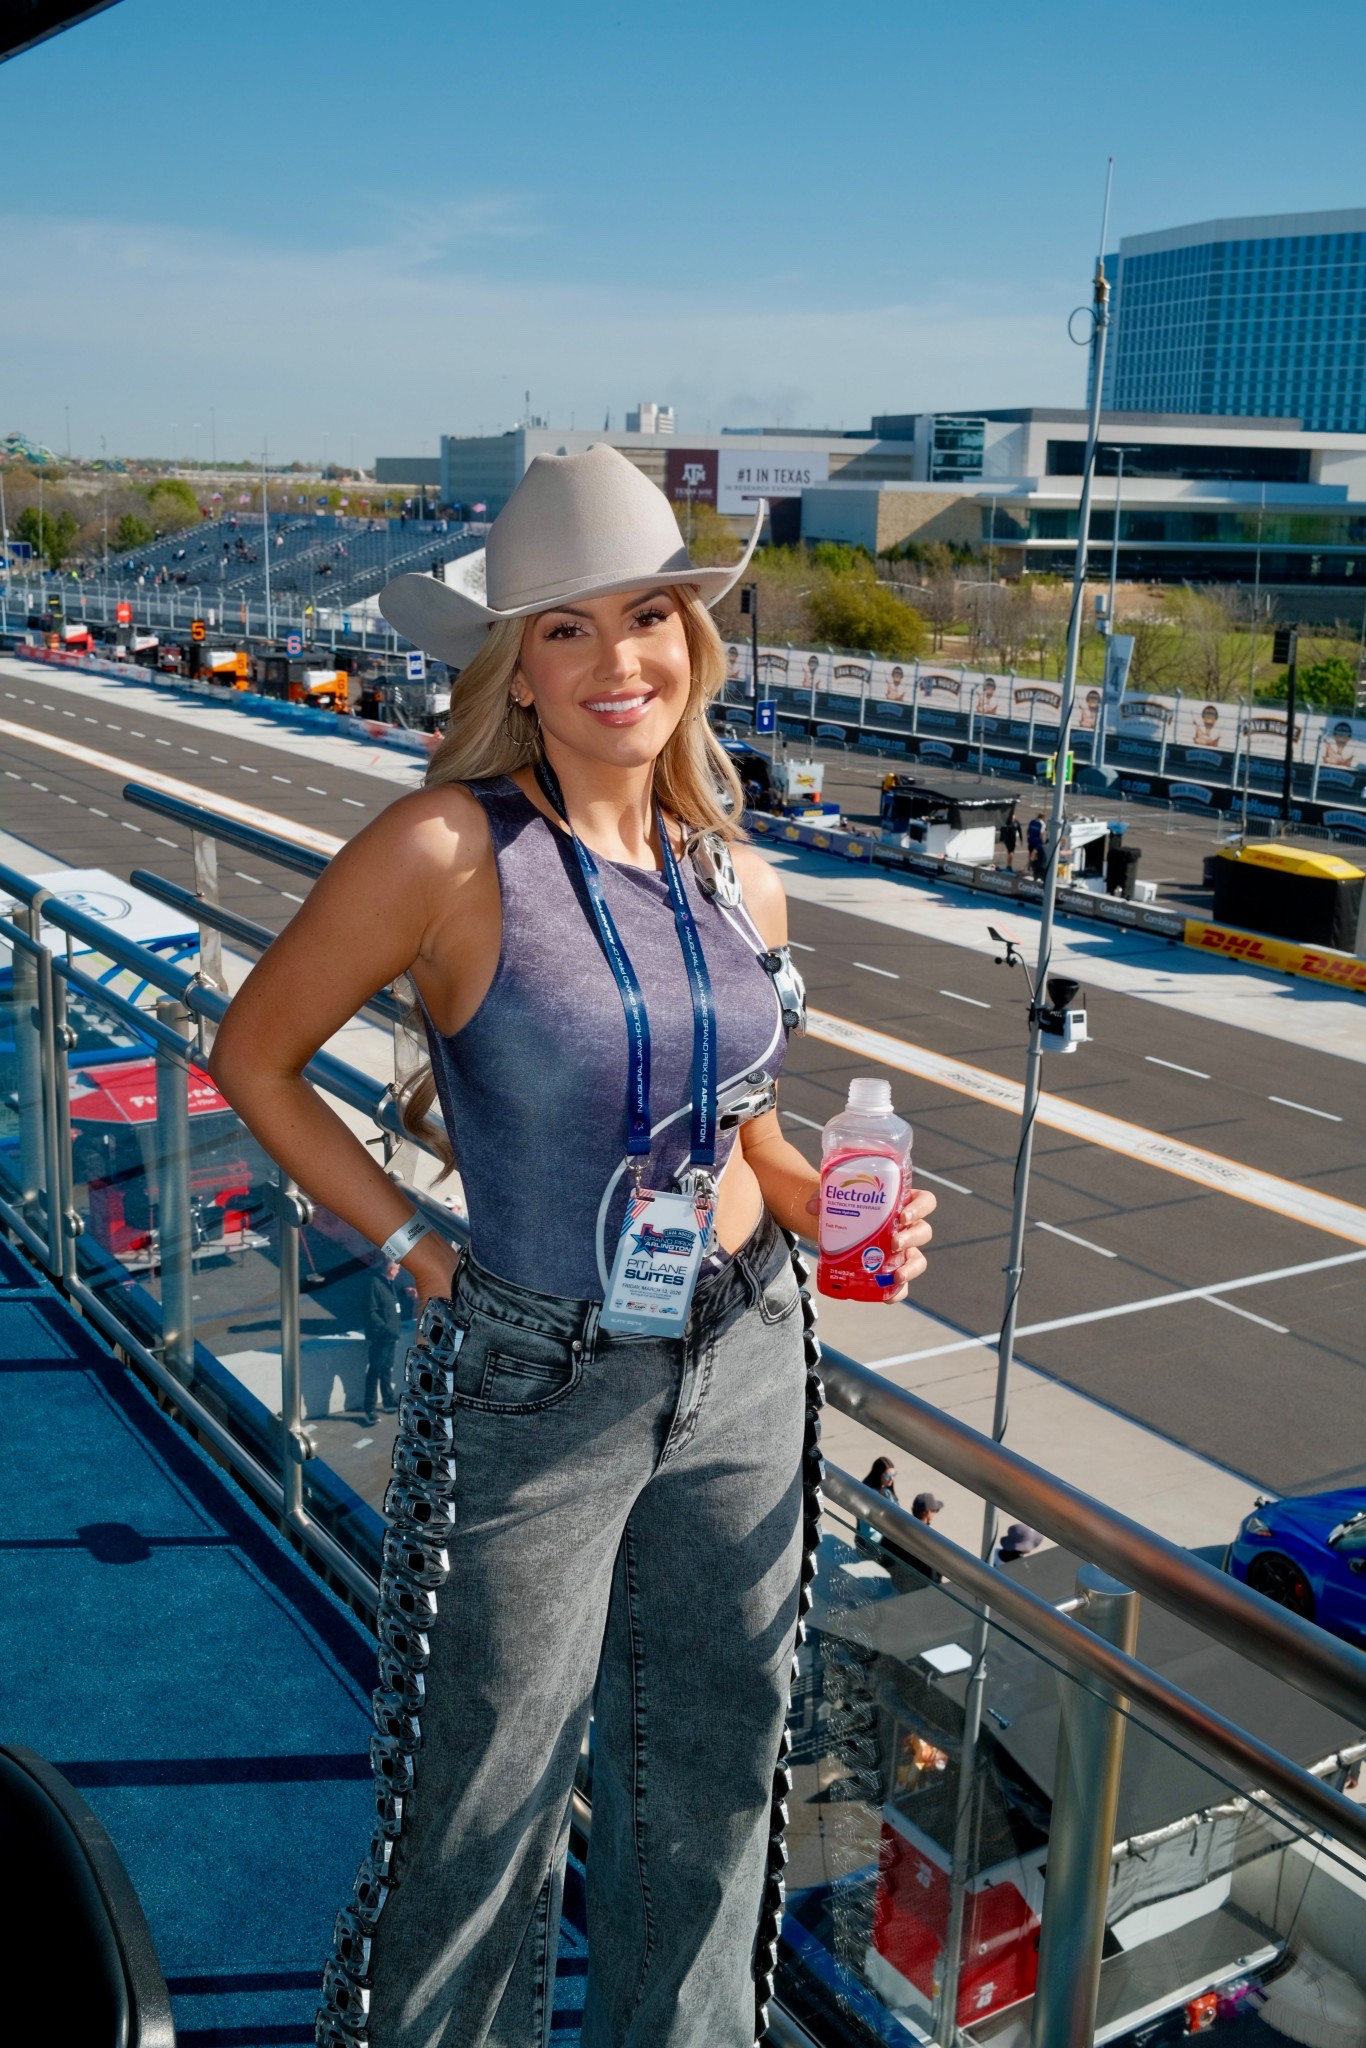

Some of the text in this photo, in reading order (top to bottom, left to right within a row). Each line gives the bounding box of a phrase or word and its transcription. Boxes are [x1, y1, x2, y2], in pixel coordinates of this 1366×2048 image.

[737, 468, 811, 484] #1 IN TEXAS
[192, 622, 206, 641] 5
[287, 635, 302, 654] 6
[238, 659, 244, 669] 5
[1110, 666, 1119, 692] 4
[1269, 720, 1299, 741] HOUE
[1172, 785, 1210, 802] JAVA HOUSE
[1327, 812, 1344, 824] JAVA
[909, 856, 938, 870] Combitrans
[944, 864, 974, 879] Combitrans
[670, 861, 684, 905] ARLINGTON
[980, 872, 1012, 888] Combitrans
[1058, 892, 1094, 909] Combitrans
[1100, 902, 1137, 919] Combitrans
[594, 896, 616, 945] ARLINGTON
[1144, 912, 1182, 931] Combitrans
[612, 946, 620, 956] OF
[685, 926, 699, 967] INAUGURAL
[1201, 929, 1266, 960] DHL
[616, 957, 627, 975] PRIX
[1301, 954, 1366, 986] DHL
[695, 968, 704, 990] JAVA
[623, 976, 637, 1006] GRAND
[700, 989, 709, 1018] HOUSE
[632, 1007, 642, 1038] HOUSE
[702, 1074, 708, 1087] OF
[700, 1088, 708, 1143] ARLINGTON
[1148, 1144, 1238, 1178] JAVA HOUSE
[826, 1185, 887, 1204] Electrolit
[828, 1200, 856, 1209] ELECTROLYTE
[644, 1236, 693, 1248] GRAND PRIX
[644, 1241, 692, 1253] ARLINGTON
[626, 1258, 688, 1276] PIT LANE
[624, 1268, 685, 1286] SUITES
[642, 1285, 661, 1293] MARCH
